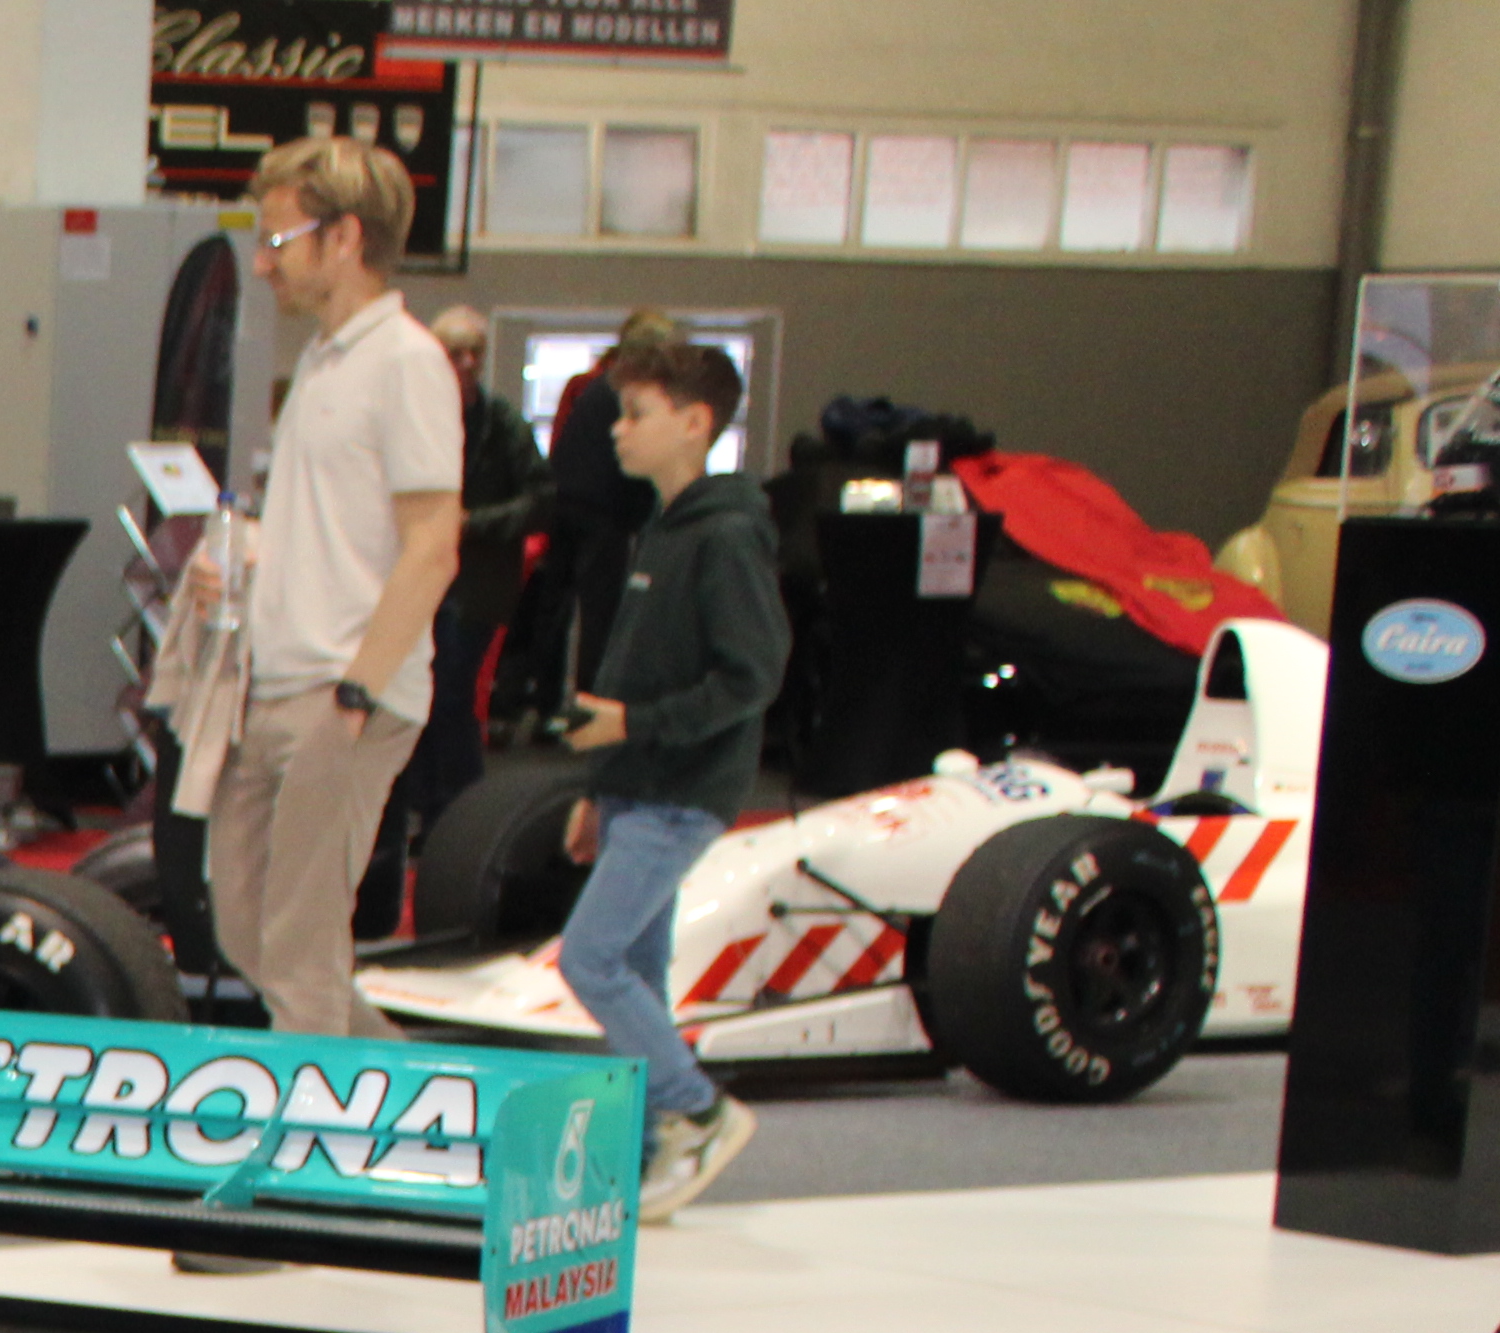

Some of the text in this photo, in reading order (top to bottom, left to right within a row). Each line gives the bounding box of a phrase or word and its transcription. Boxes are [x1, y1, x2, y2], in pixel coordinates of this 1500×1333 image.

[524, 10, 562, 41] EN
[571, 12, 719, 46] MODELLEN
[509, 1200, 624, 1264] PETRONAS
[504, 1258, 618, 1320] MALAYSIA
